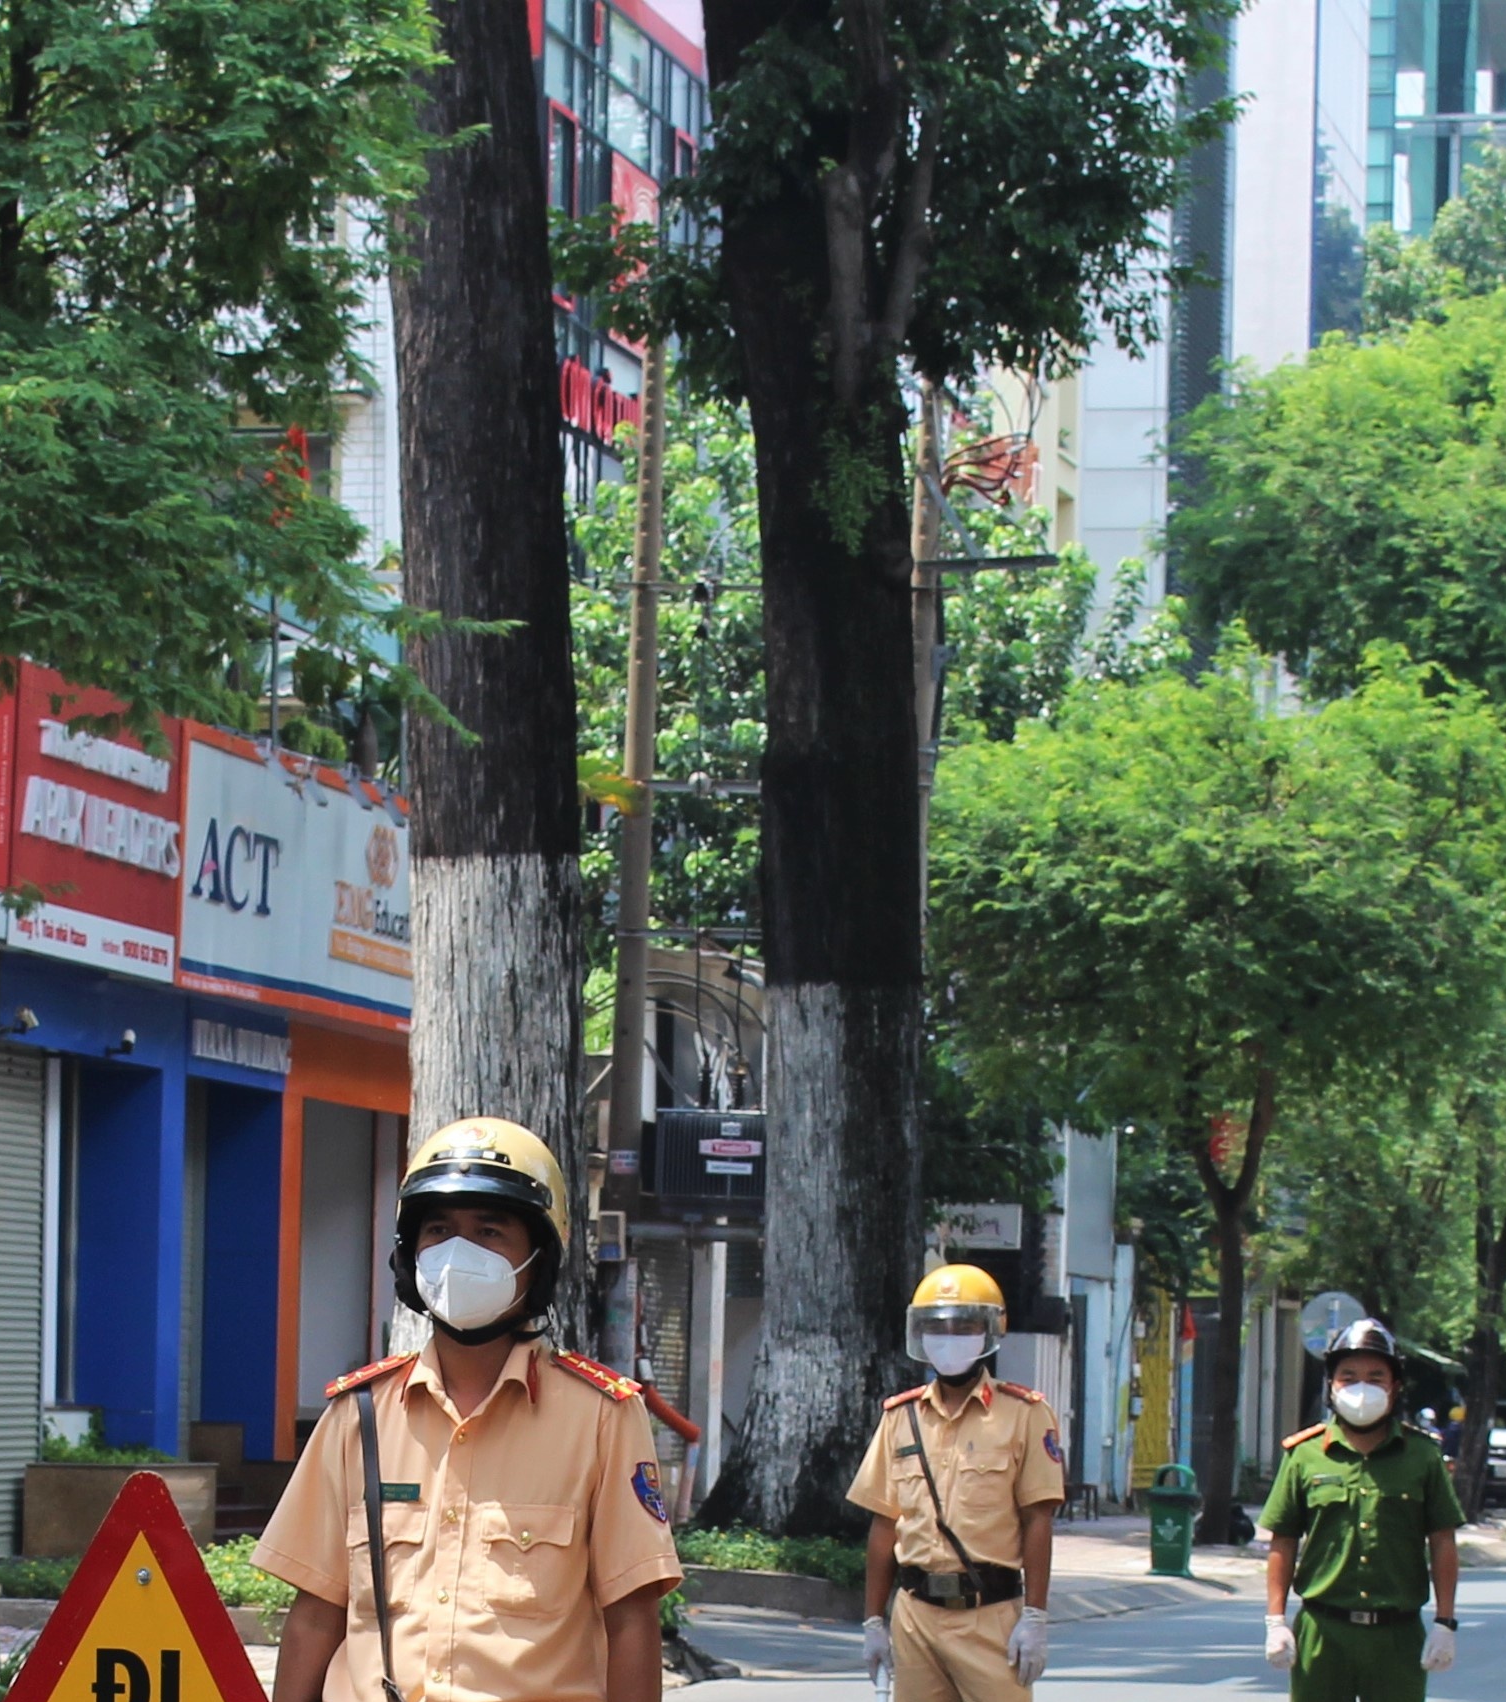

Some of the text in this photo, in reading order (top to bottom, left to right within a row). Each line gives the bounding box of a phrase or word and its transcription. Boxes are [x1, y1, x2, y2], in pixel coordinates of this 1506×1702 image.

[83, 794, 180, 879] LEADERS
[191, 818, 282, 917] ACT
[373, 898, 410, 943] Educat
